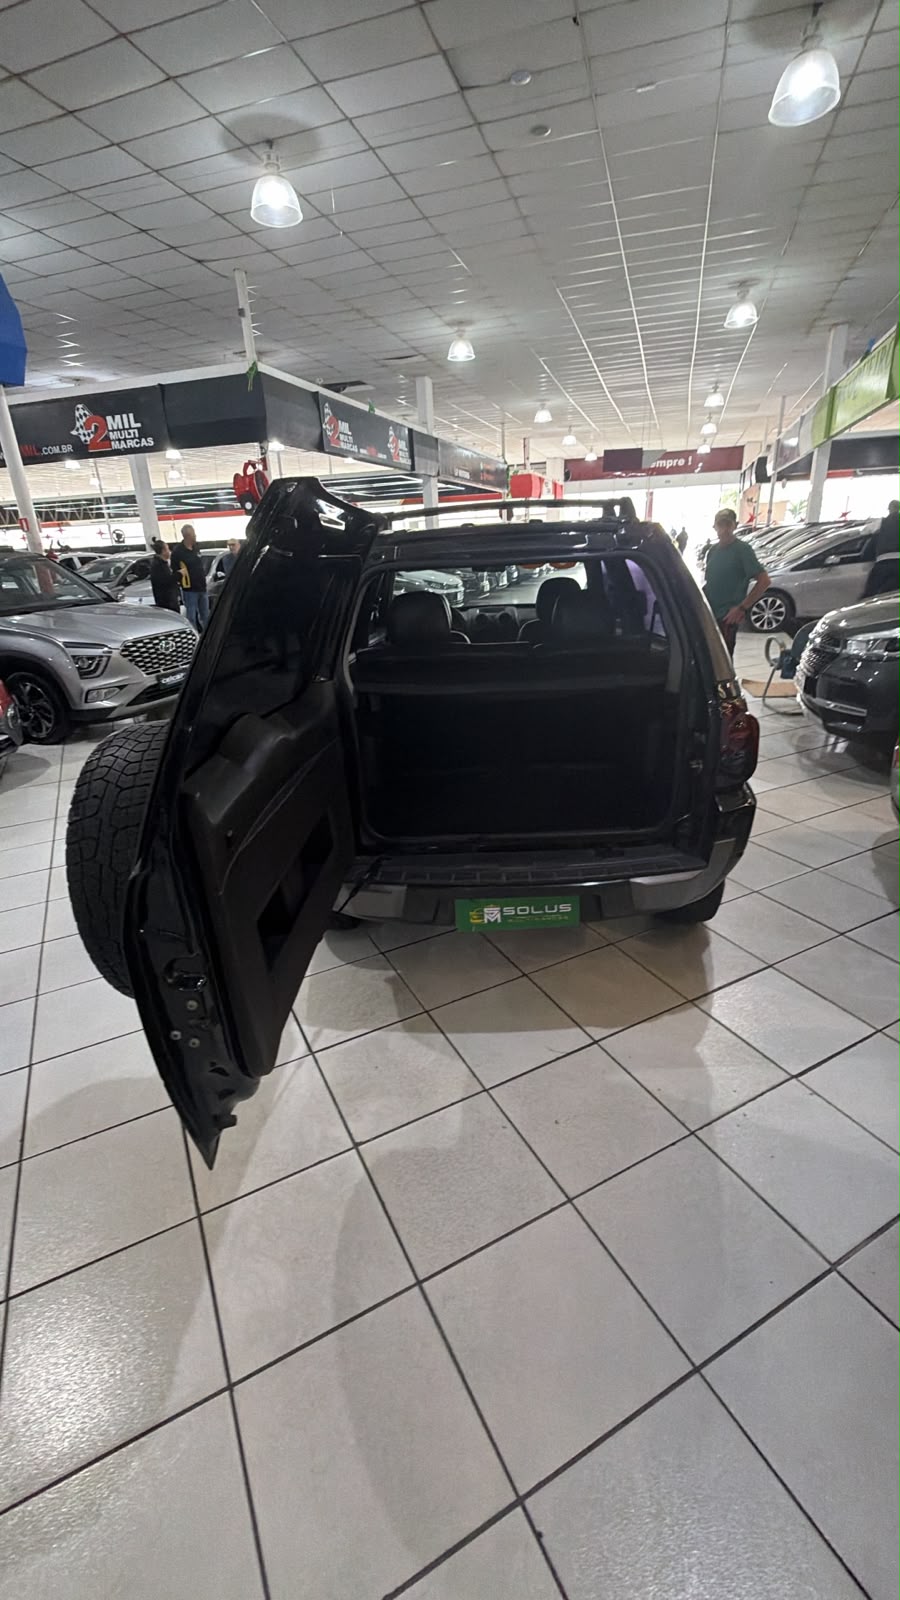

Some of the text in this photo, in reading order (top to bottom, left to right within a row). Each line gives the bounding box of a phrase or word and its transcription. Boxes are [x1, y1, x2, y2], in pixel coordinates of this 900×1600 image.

[84, 413, 141, 452] 2 MIL
[109, 429, 139, 441] MULTI
[111, 438, 154, 450] MARCAS
[503, 904, 572, 915] SOLUS
